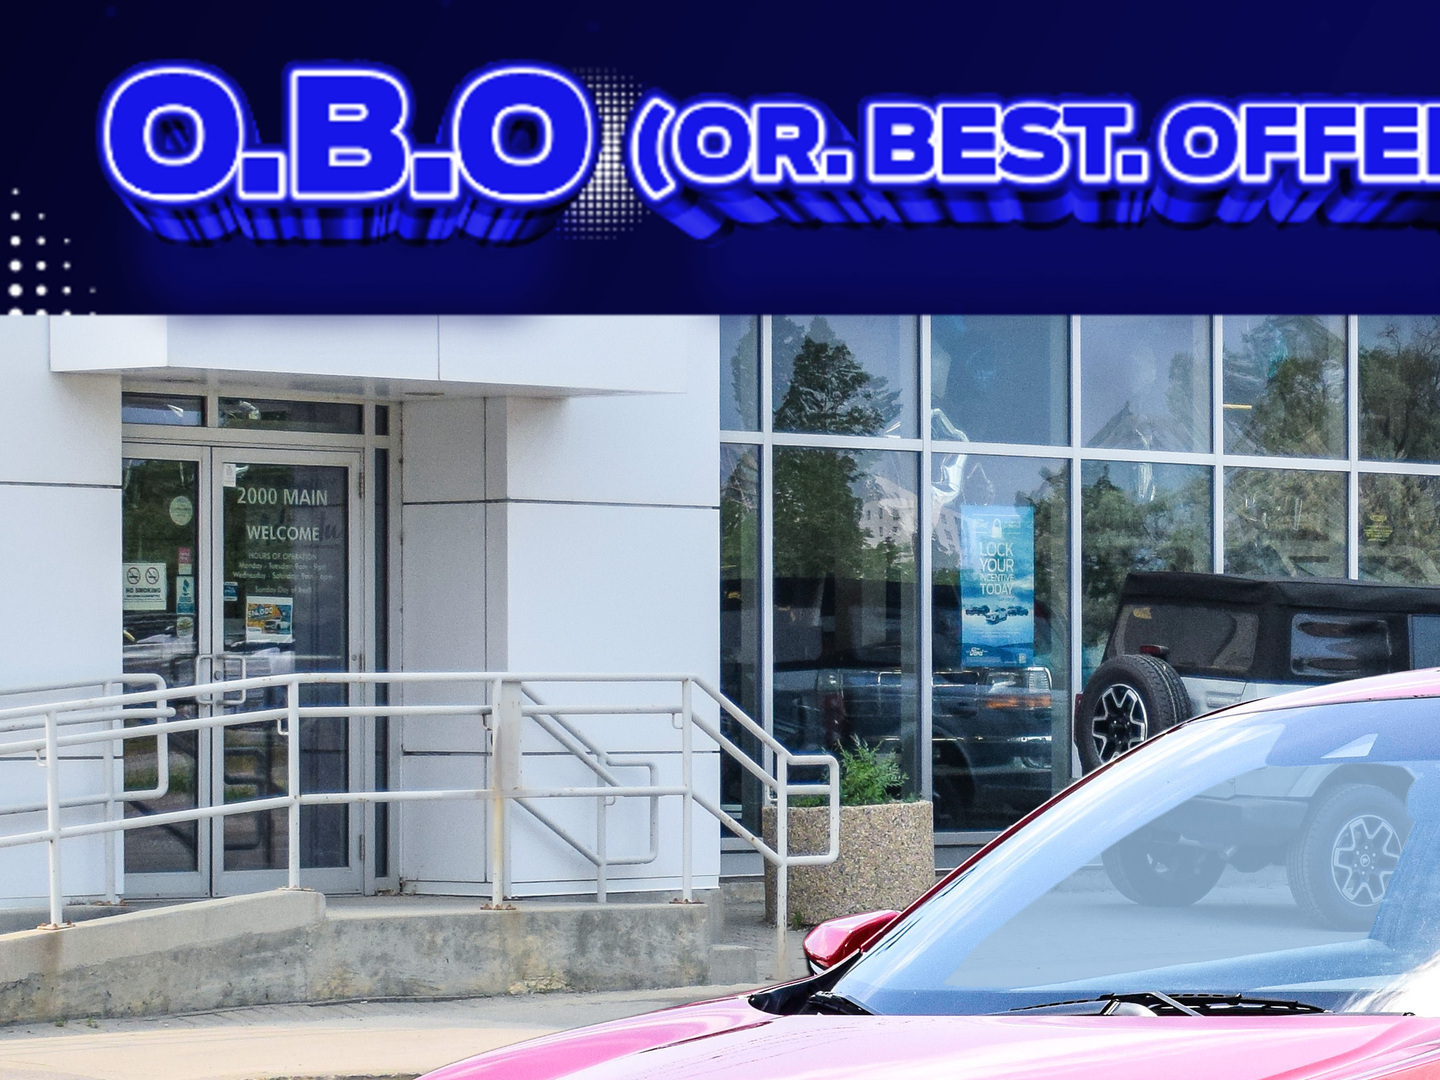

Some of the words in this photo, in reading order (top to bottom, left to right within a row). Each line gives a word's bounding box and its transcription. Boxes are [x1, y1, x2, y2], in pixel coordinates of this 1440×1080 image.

[237, 487, 278, 505] 2000
[283, 488, 328, 506] MAIN
[246, 524, 320, 541] WELCOME
[248, 552, 271, 560] HOURS
[979, 541, 1014, 557] LOCK
[979, 558, 1015, 572] YOUR
[980, 583, 1014, 595] TODAY
